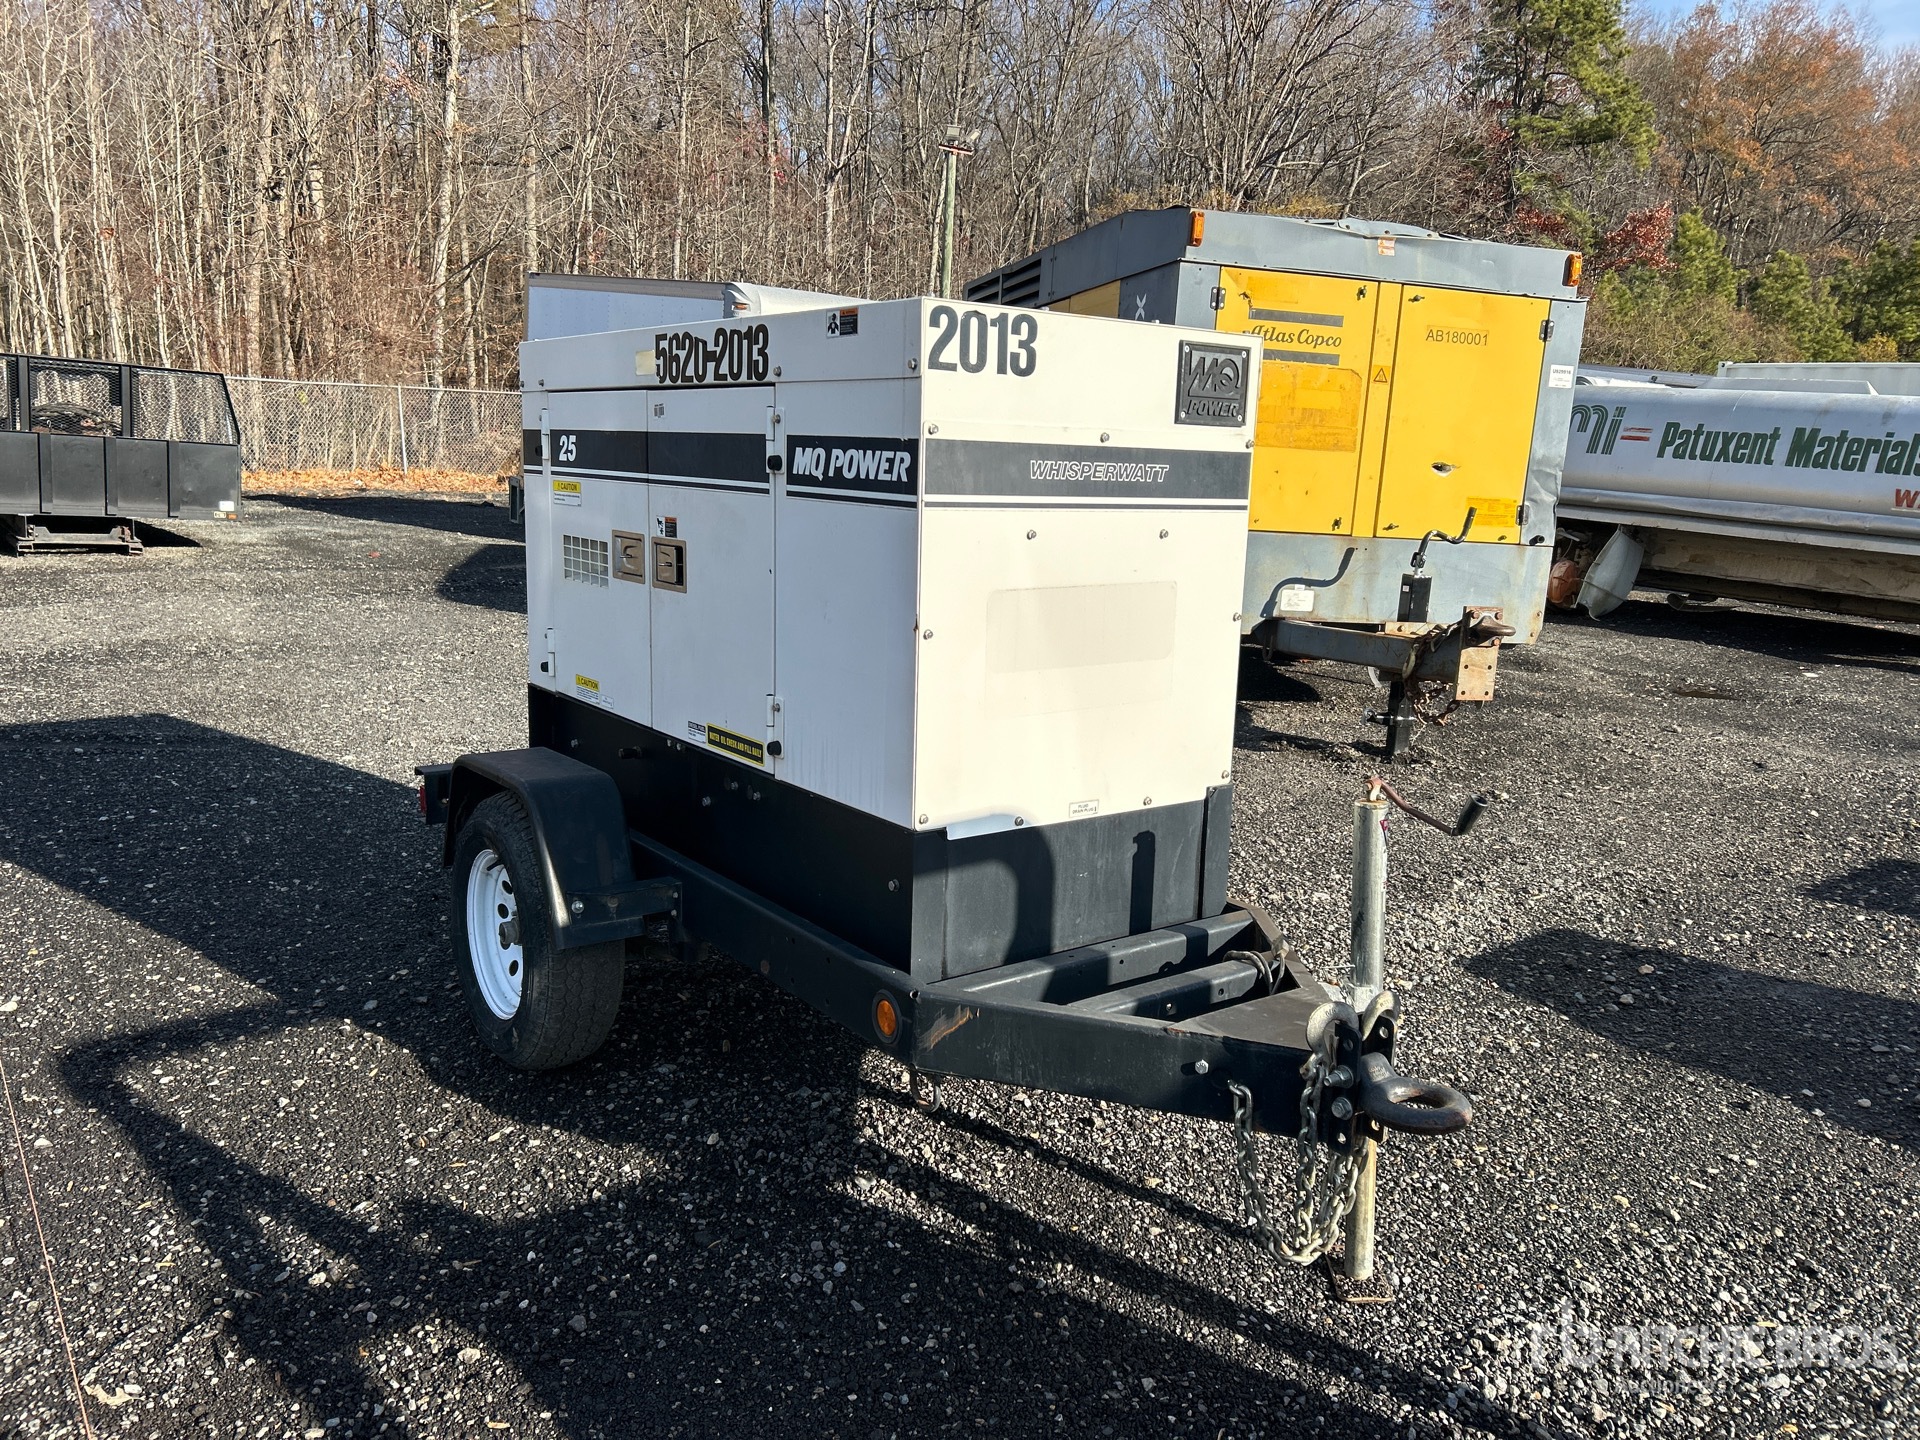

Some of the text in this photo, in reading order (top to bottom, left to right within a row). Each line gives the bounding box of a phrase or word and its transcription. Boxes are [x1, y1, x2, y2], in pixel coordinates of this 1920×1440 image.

[927, 304, 1038, 378] 2013
[1251, 325, 1342, 348] Atlas Copco
[1425, 329, 1488, 346] AB180001
[655, 324, 769, 384] 5620-2013
[1185, 350, 1241, 396] MQ
[1187, 400, 1239, 417] POWER
[558, 434, 577, 462] 25
[1656, 421, 1781, 466] Patuxent
[792, 447, 912, 482] MQ POWER
[1030, 460, 1169, 482] WHISPERWATT
[560, 482, 578, 491] CAUTION
[581, 677, 599, 690] CAUTION
